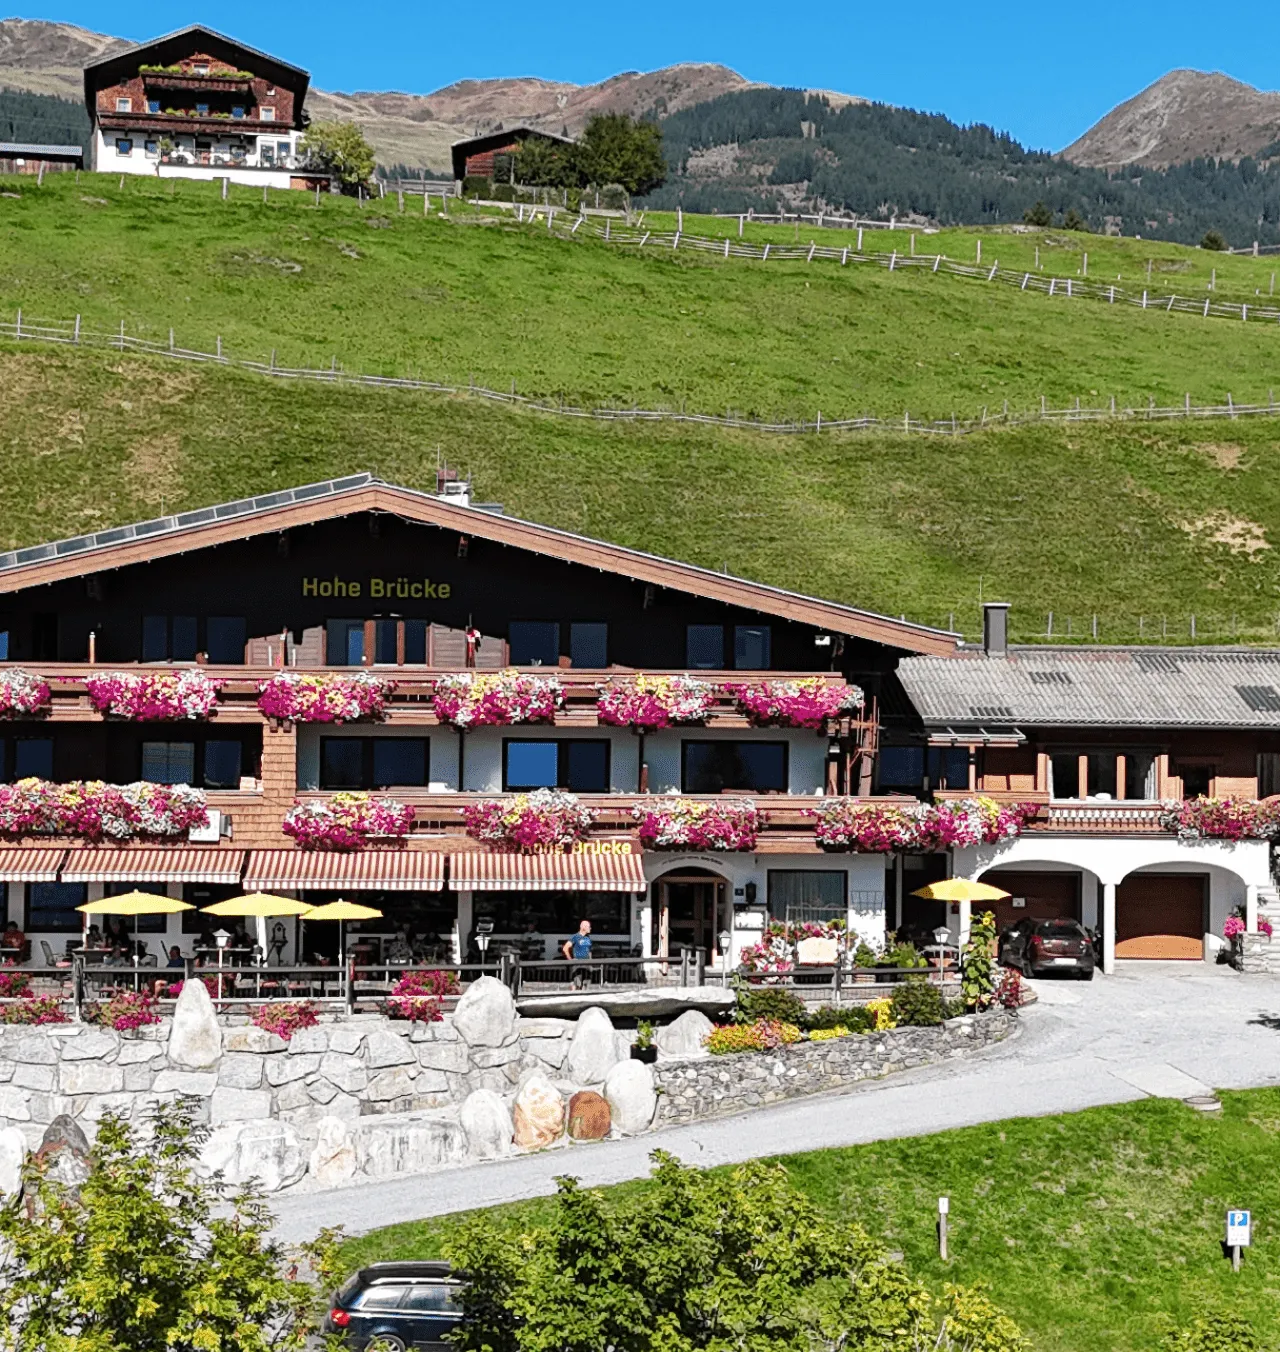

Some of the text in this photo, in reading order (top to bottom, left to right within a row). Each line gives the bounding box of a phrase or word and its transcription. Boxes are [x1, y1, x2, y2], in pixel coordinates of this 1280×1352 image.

[302, 576, 451, 599] Hohe Brücke
[1234, 1213, 1243, 1226] P
